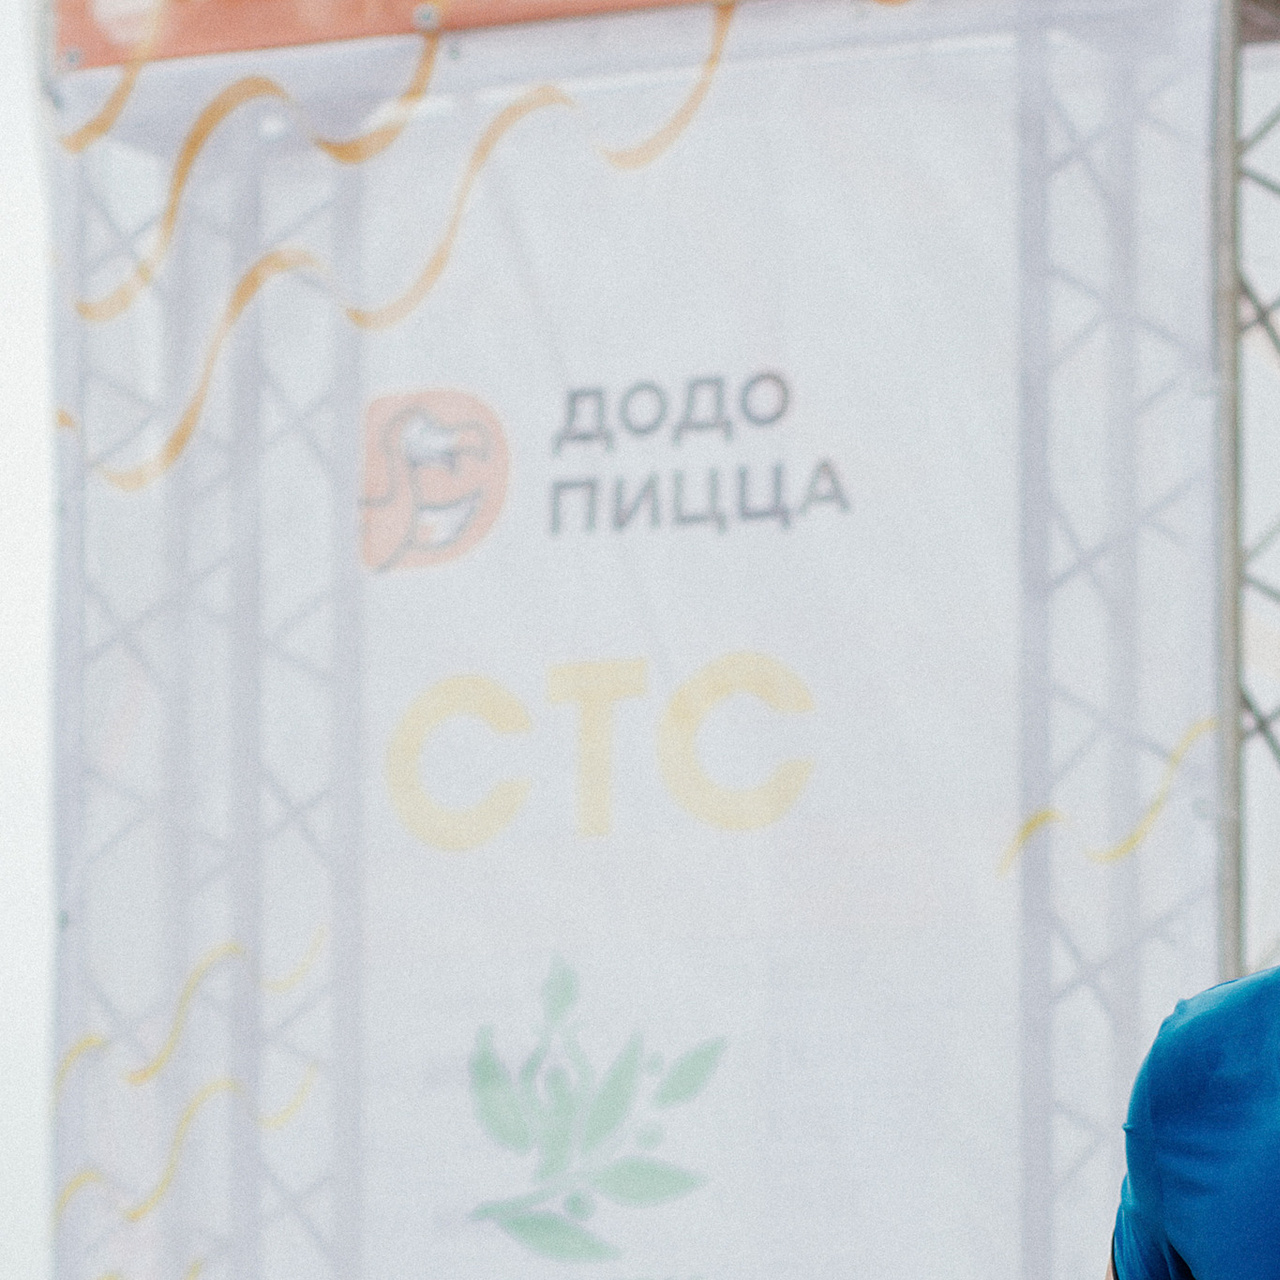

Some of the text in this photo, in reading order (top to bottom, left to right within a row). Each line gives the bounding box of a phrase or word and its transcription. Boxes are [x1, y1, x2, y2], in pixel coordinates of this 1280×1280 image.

[551, 369, 791, 456] ДОДО
[549, 456, 851, 536] ПИЦЦА
[386, 649, 816, 852] СТС
